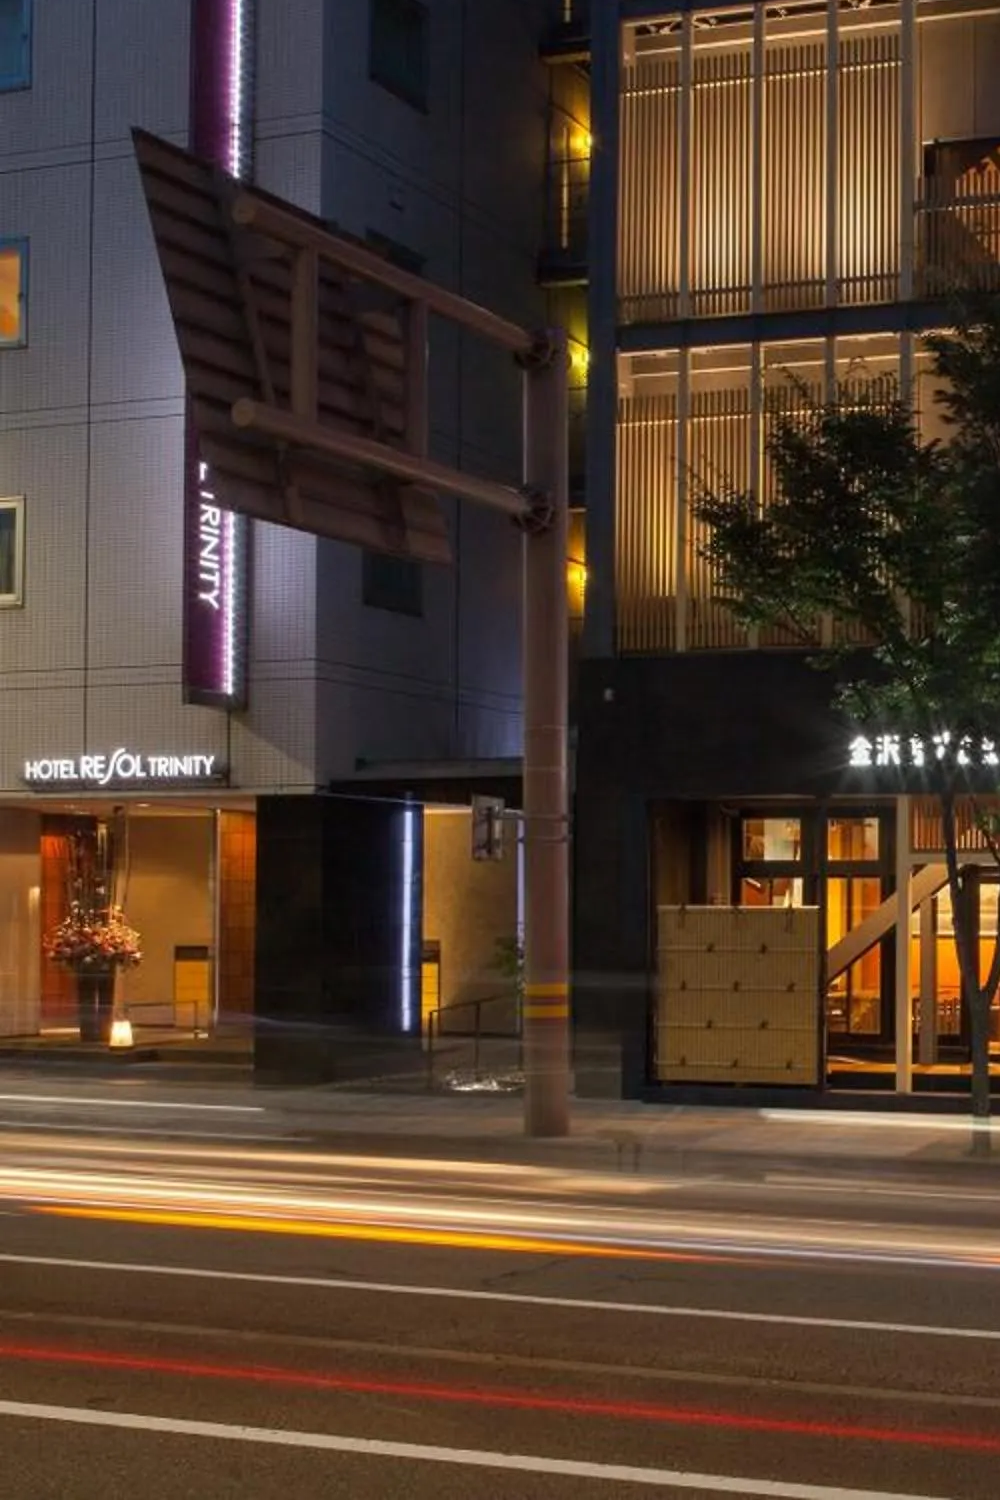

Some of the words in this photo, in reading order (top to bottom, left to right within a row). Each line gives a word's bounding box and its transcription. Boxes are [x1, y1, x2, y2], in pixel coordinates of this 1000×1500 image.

[25, 760, 78, 780] HOTEL
[80, 748, 146, 785] RESOL
[148, 755, 215, 777] TRINITY
